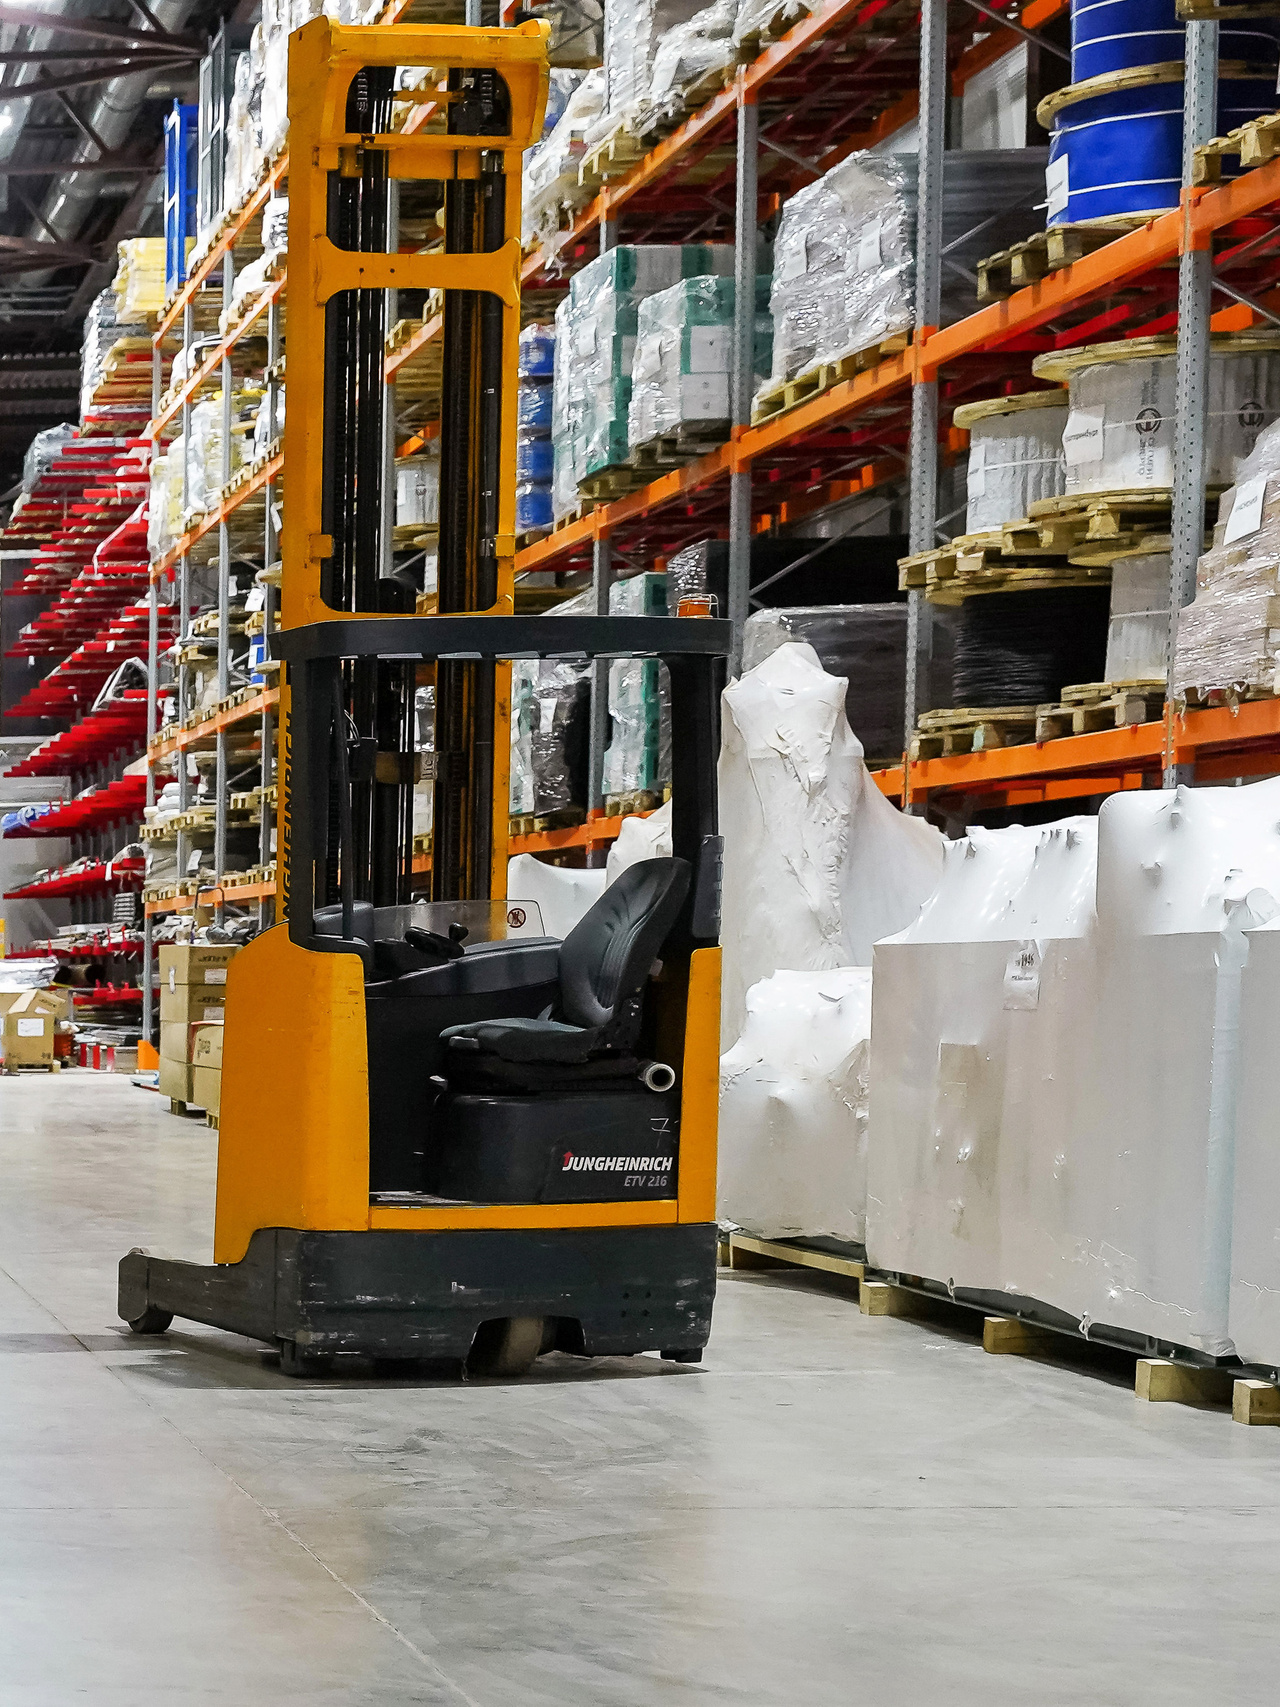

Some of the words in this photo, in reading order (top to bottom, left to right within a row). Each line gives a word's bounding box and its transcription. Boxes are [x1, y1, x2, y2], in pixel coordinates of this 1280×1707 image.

[562, 1156, 673, 1171] JUNGHEINRICH
[624, 1175, 645, 1187] ETV
[647, 1175, 668, 1187] 216
